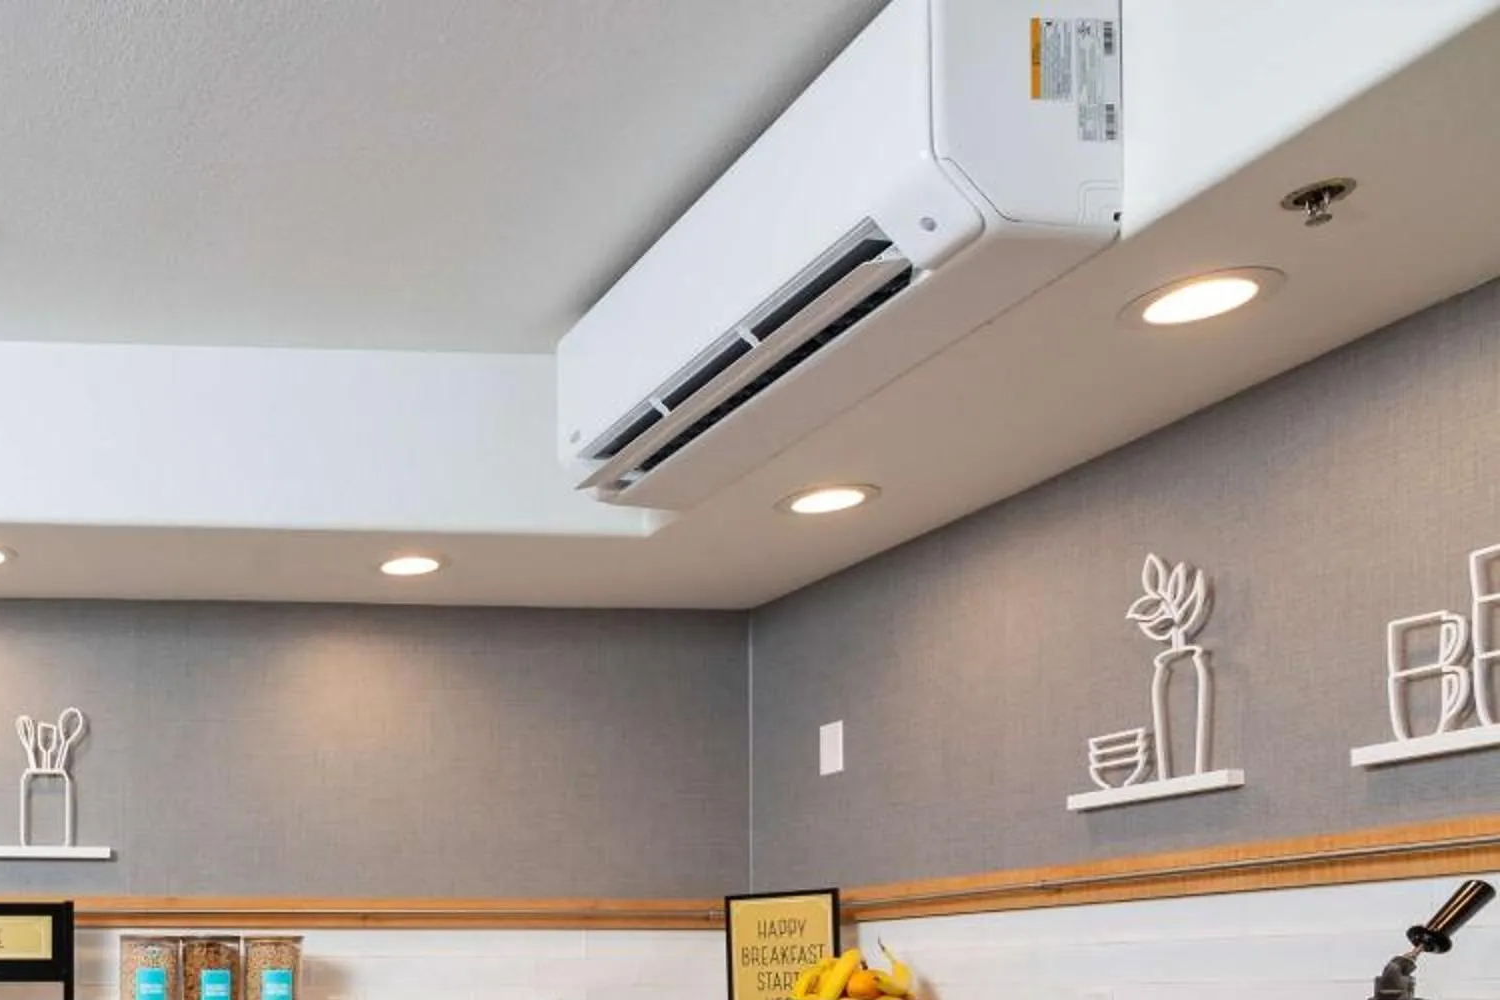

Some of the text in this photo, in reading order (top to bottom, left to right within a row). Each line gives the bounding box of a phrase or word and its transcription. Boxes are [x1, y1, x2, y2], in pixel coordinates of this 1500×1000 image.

[757, 918, 807, 939] HAPPY
[741, 943, 827, 967] BREAKFAST
[756, 971, 802, 991] START
